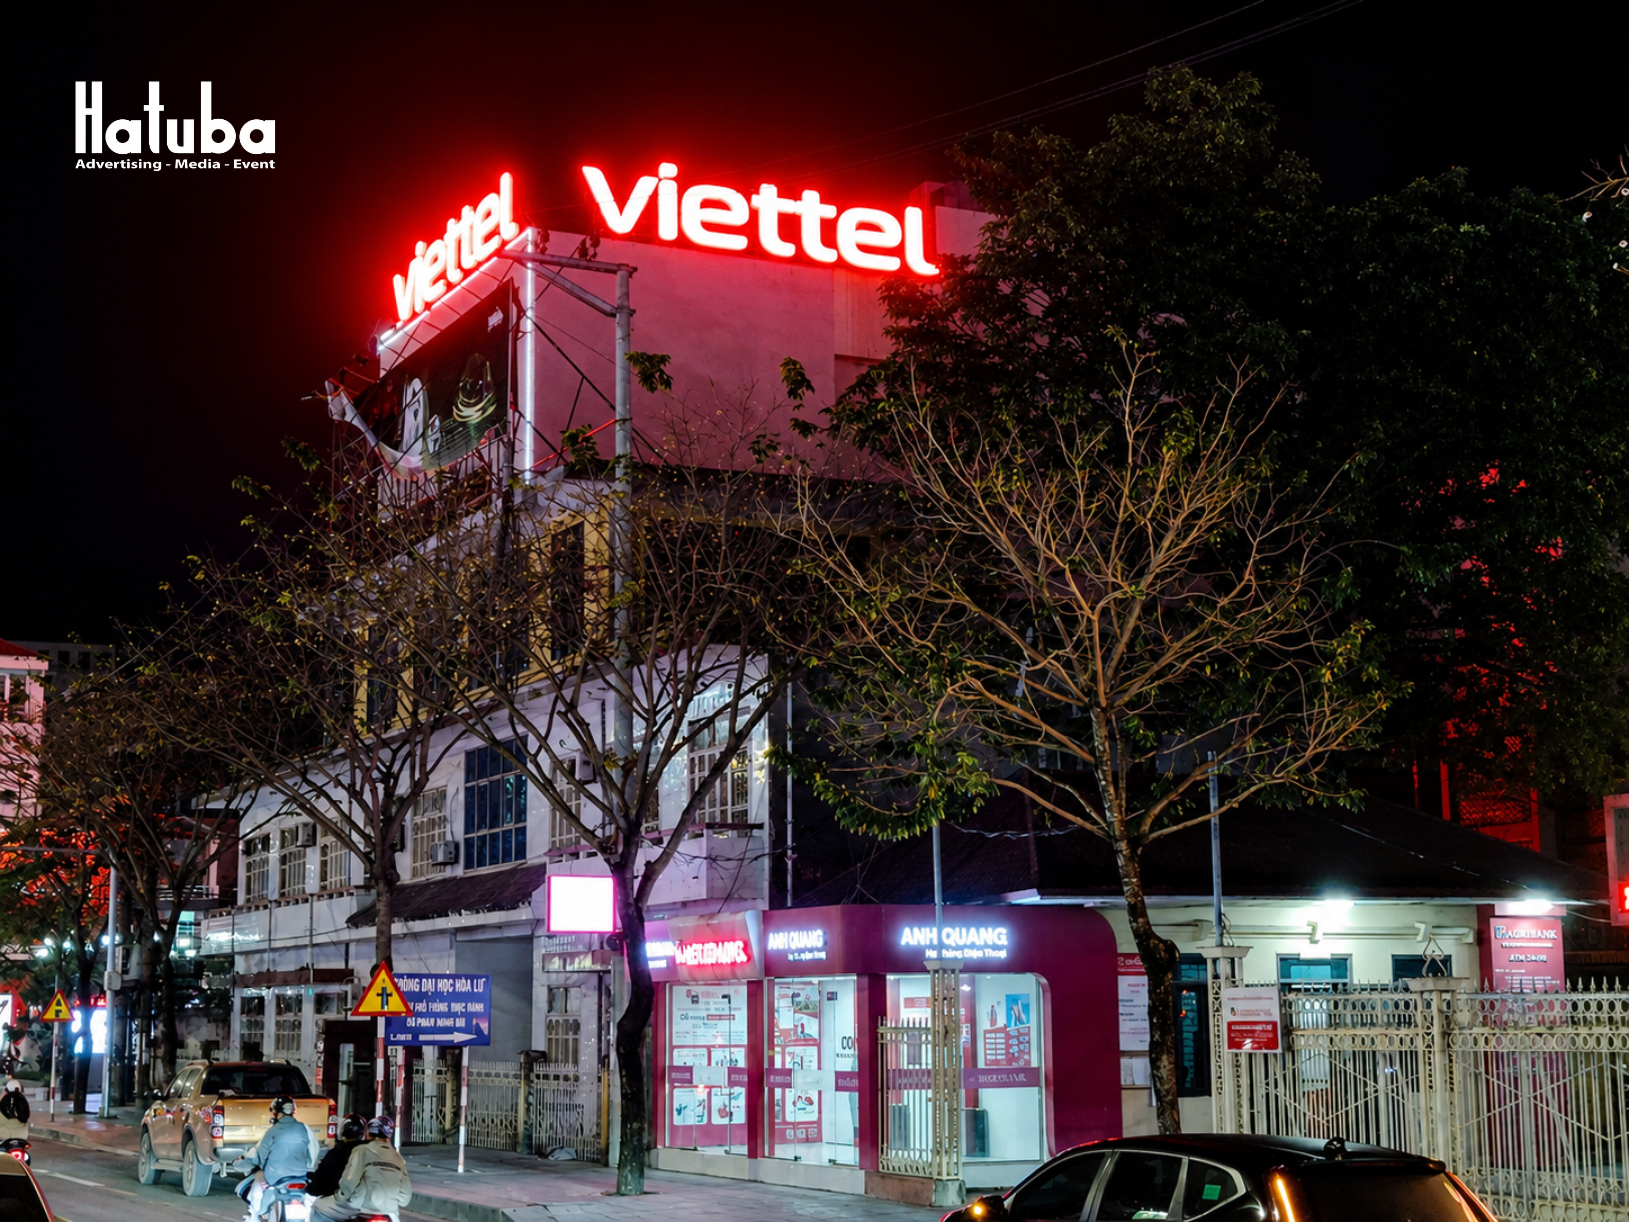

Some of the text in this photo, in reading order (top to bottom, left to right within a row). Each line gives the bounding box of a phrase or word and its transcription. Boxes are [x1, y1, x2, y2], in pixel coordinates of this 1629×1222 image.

[392, 172, 518, 322] viettel
[582, 162, 940, 275] viettel
[768, 929, 824, 950] ANH QUANG
[900, 927, 1008, 947] ANH QUANG
